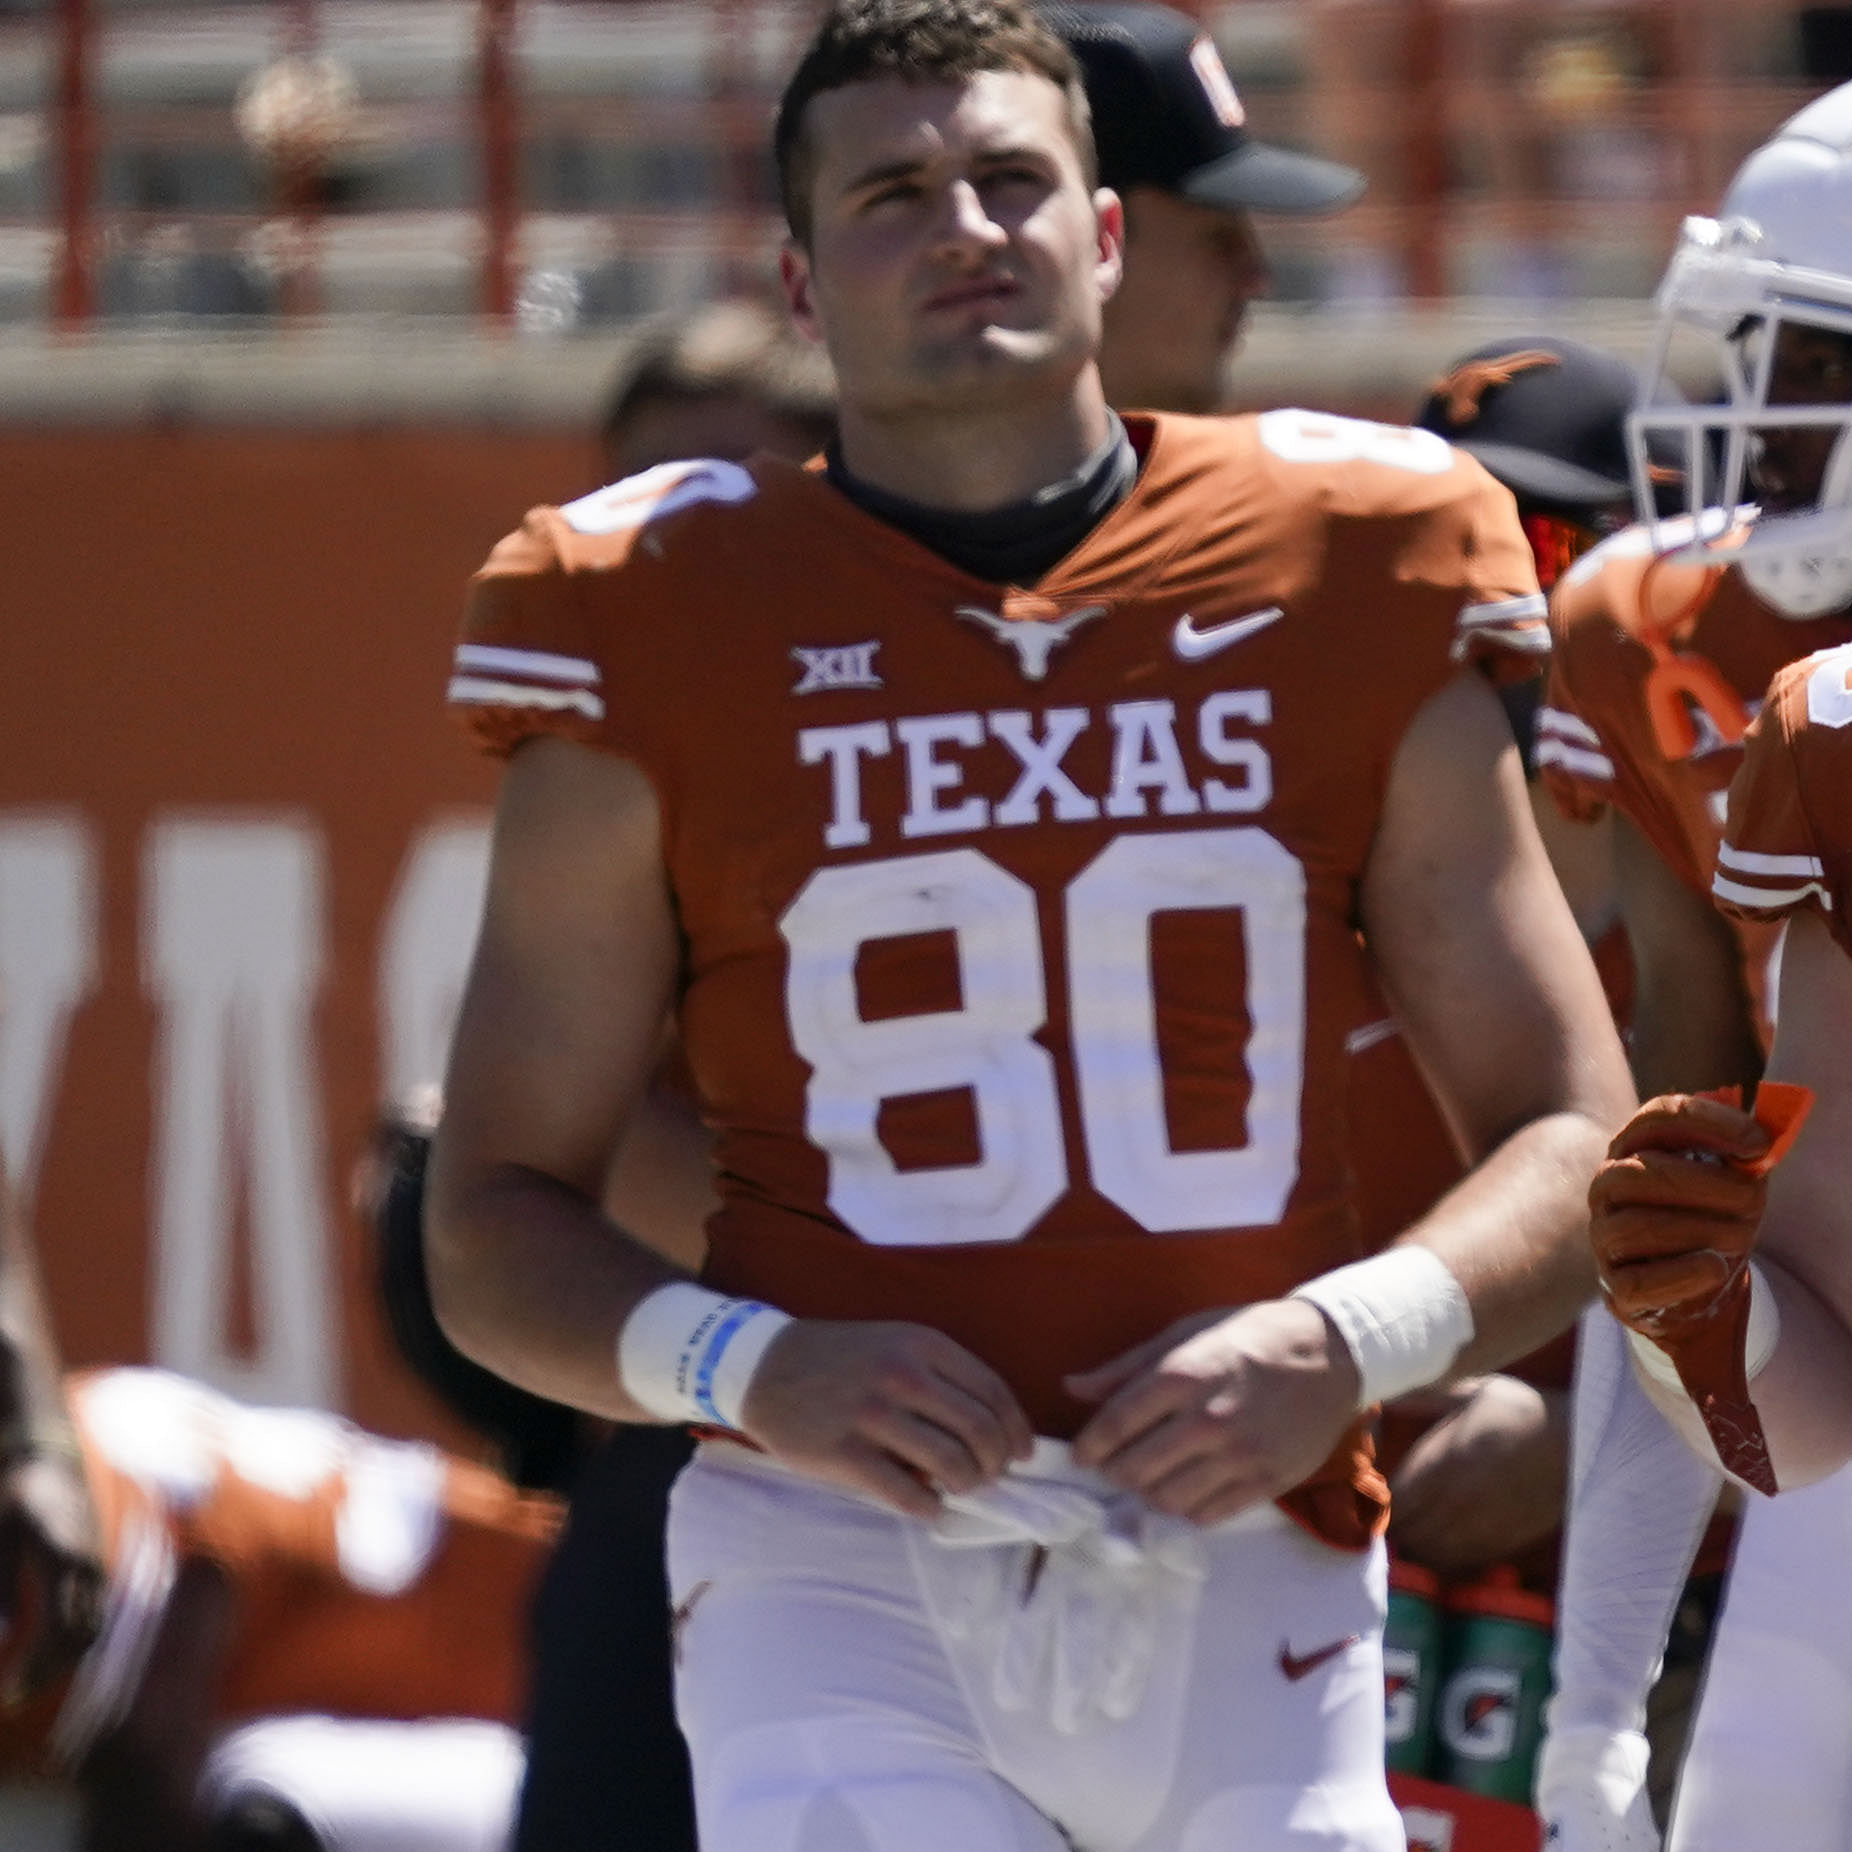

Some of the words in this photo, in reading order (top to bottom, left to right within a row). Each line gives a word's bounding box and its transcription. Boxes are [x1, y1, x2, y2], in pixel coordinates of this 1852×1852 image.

[799, 690, 1273, 849] TEXAS
[778, 825, 1307, 1247] 80
[1440, 1666, 1522, 1762] G
